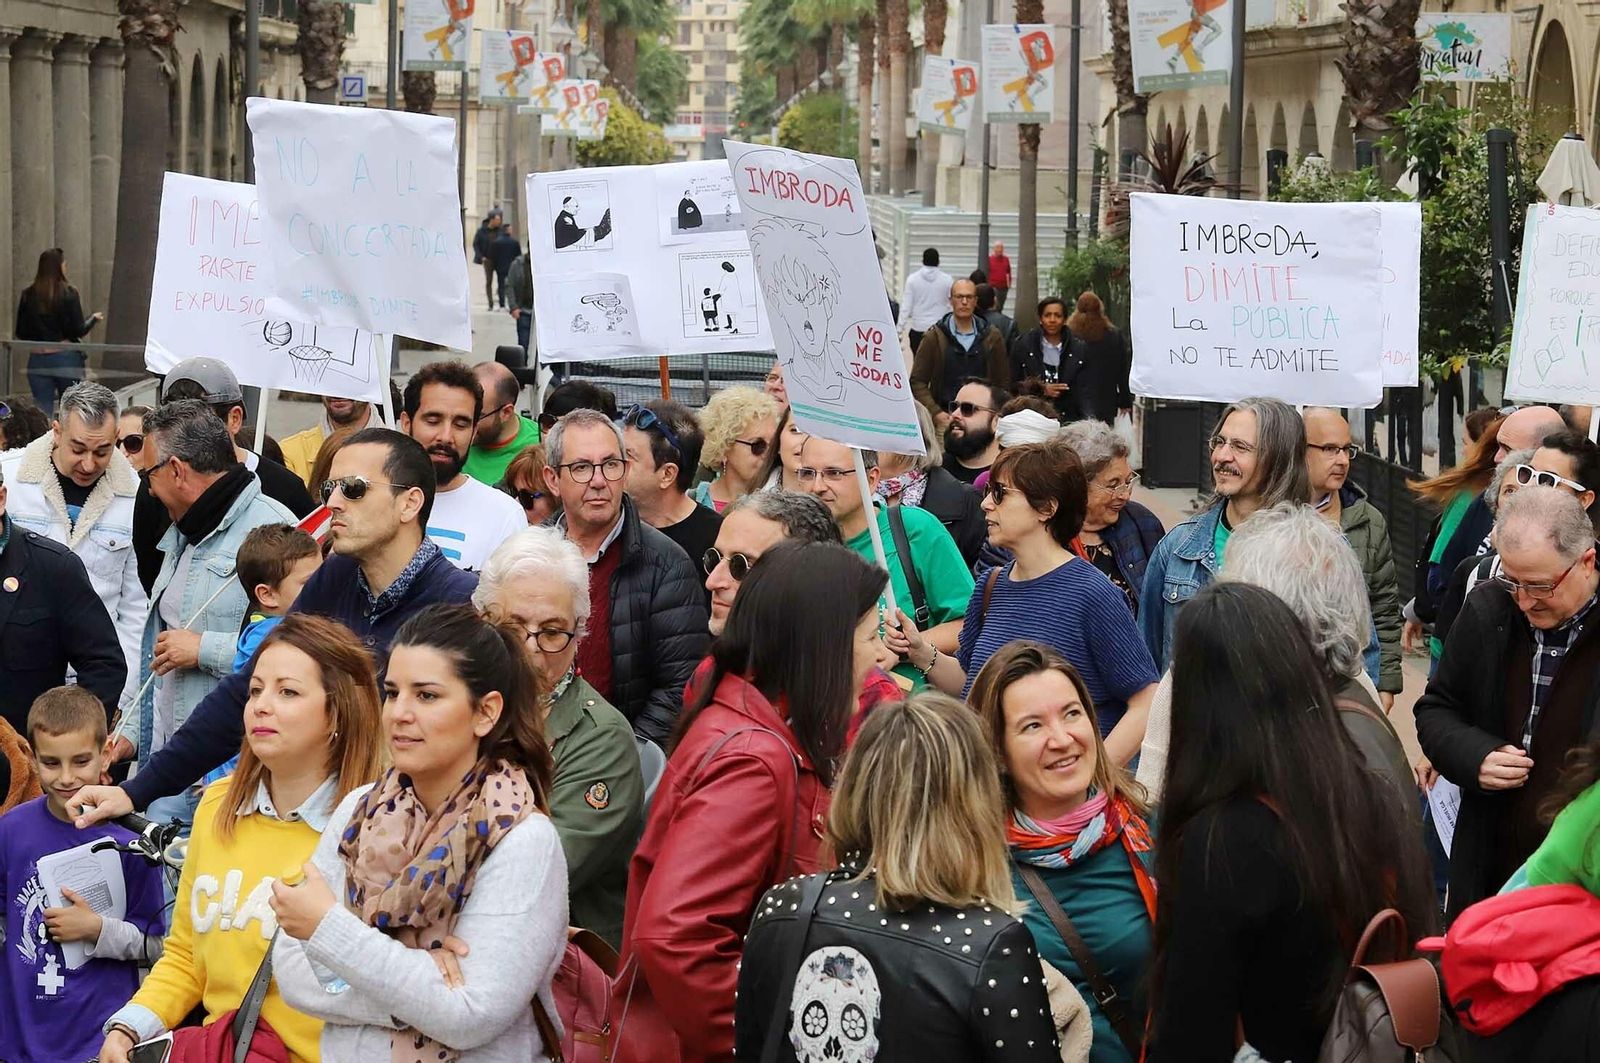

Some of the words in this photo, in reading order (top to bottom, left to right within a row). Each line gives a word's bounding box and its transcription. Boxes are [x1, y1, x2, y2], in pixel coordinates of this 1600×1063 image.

[274, 136, 319, 187] NO
[352, 153, 376, 194] A
[744, 167, 855, 213] IMBRODA
[198, 255, 257, 282] PARTE
[1549, 287, 1597, 306] PORQUE
[856, 325, 883, 345] NO
[1549, 316, 1568, 331] ES
[855, 342, 883, 362] ME
[1169, 345, 1198, 365] NO
[1213, 346, 1243, 368] TE
[1250, 347, 1339, 372] ADMITE
[850, 362, 902, 389] JODAS
